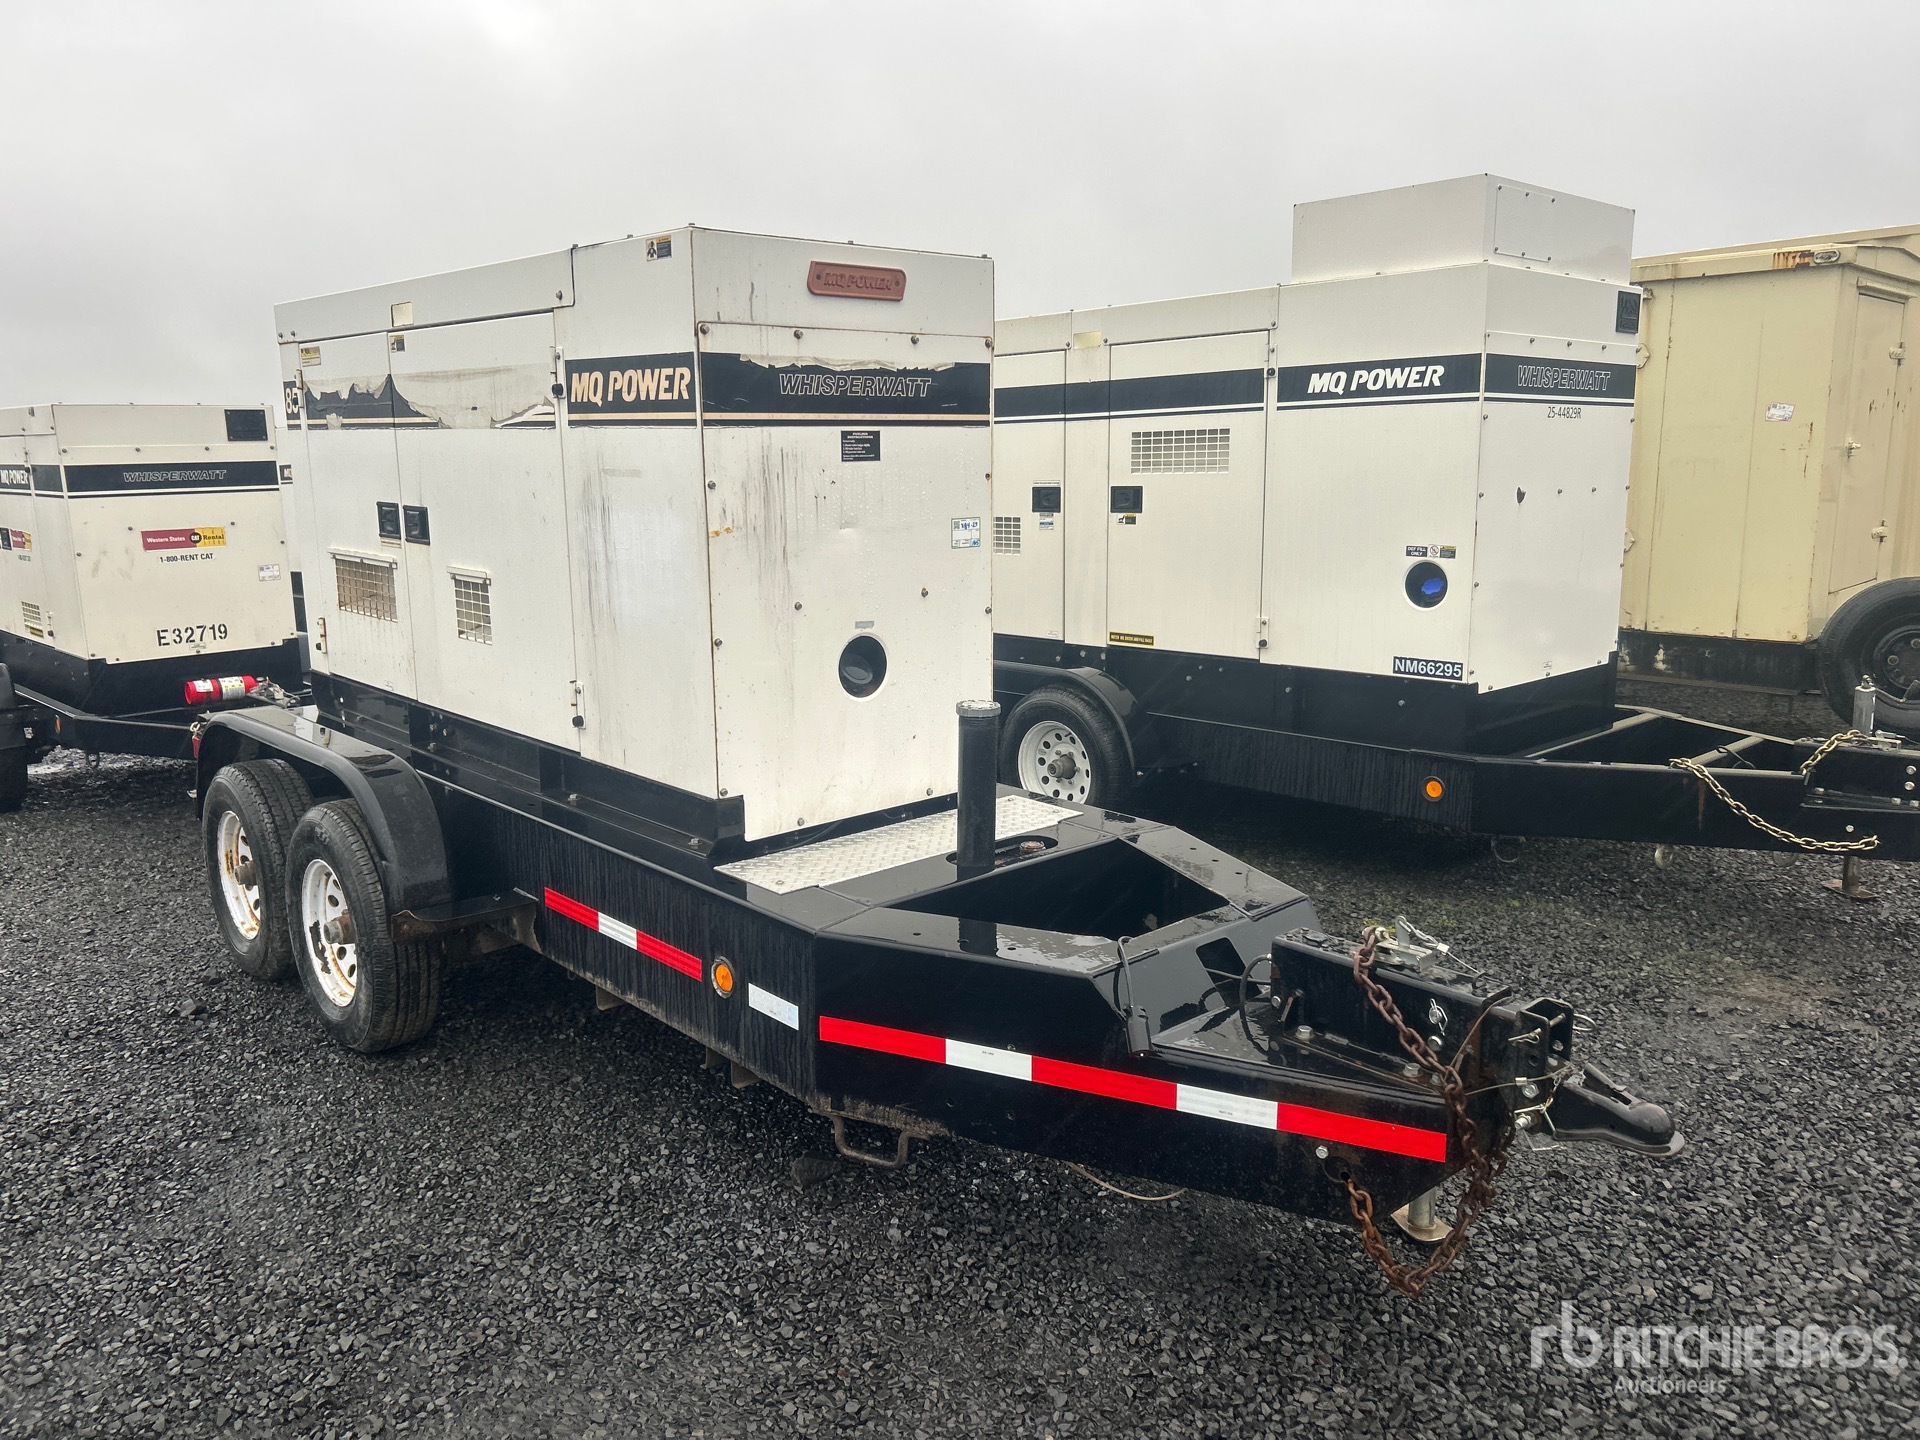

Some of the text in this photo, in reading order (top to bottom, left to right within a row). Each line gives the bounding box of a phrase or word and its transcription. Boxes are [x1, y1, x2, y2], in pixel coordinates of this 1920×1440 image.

[823, 272, 892, 291] MQ POWER
[570, 366, 692, 408] MQ POWER
[779, 373, 932, 398] WHISPERWATT
[1307, 365, 1446, 396] MQ POWER
[1517, 365, 1612, 391] WHISPERWATT
[1547, 406, 1582, 420] 25-44829R
[123, 469, 227, 483] WHISPERWATT
[203, 533, 225, 541] Rental
[159, 552, 214, 564] 1-800-RENT CAT
[156, 623, 229, 647] E32719
[1394, 659, 1462, 678] NM66295
